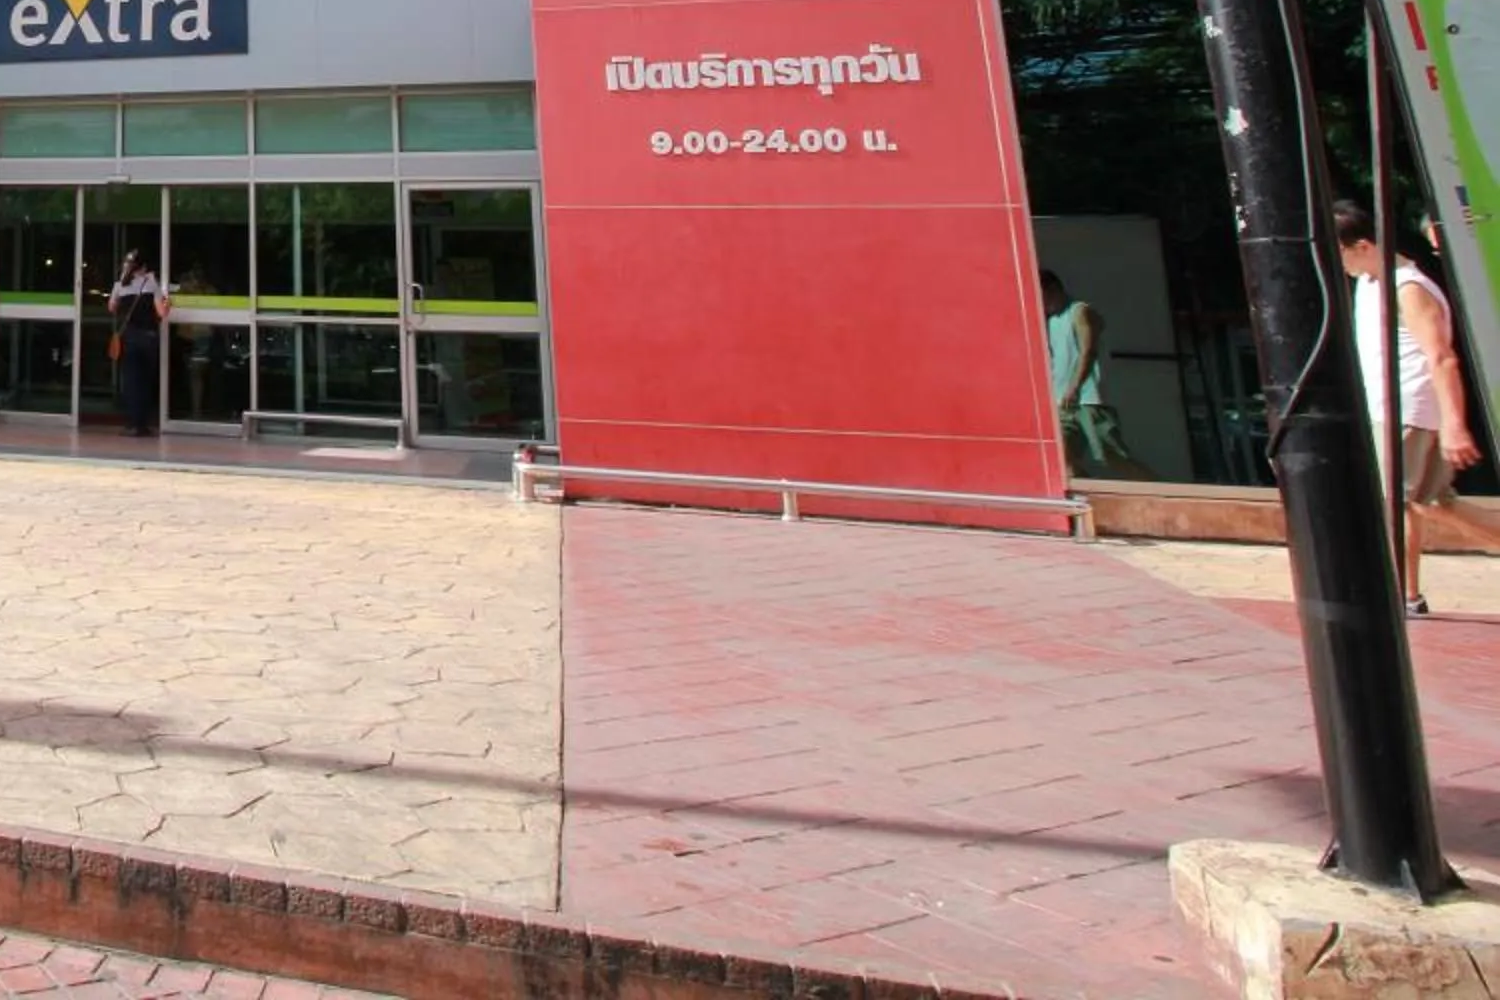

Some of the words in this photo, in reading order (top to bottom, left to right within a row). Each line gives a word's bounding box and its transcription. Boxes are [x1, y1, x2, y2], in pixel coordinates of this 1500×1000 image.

[605, 44, 921, 95] เปิดบริการทุกวัน
[650, 128, 846, 155] 9.00-24.00
[863, 129, 898, 152] น.
